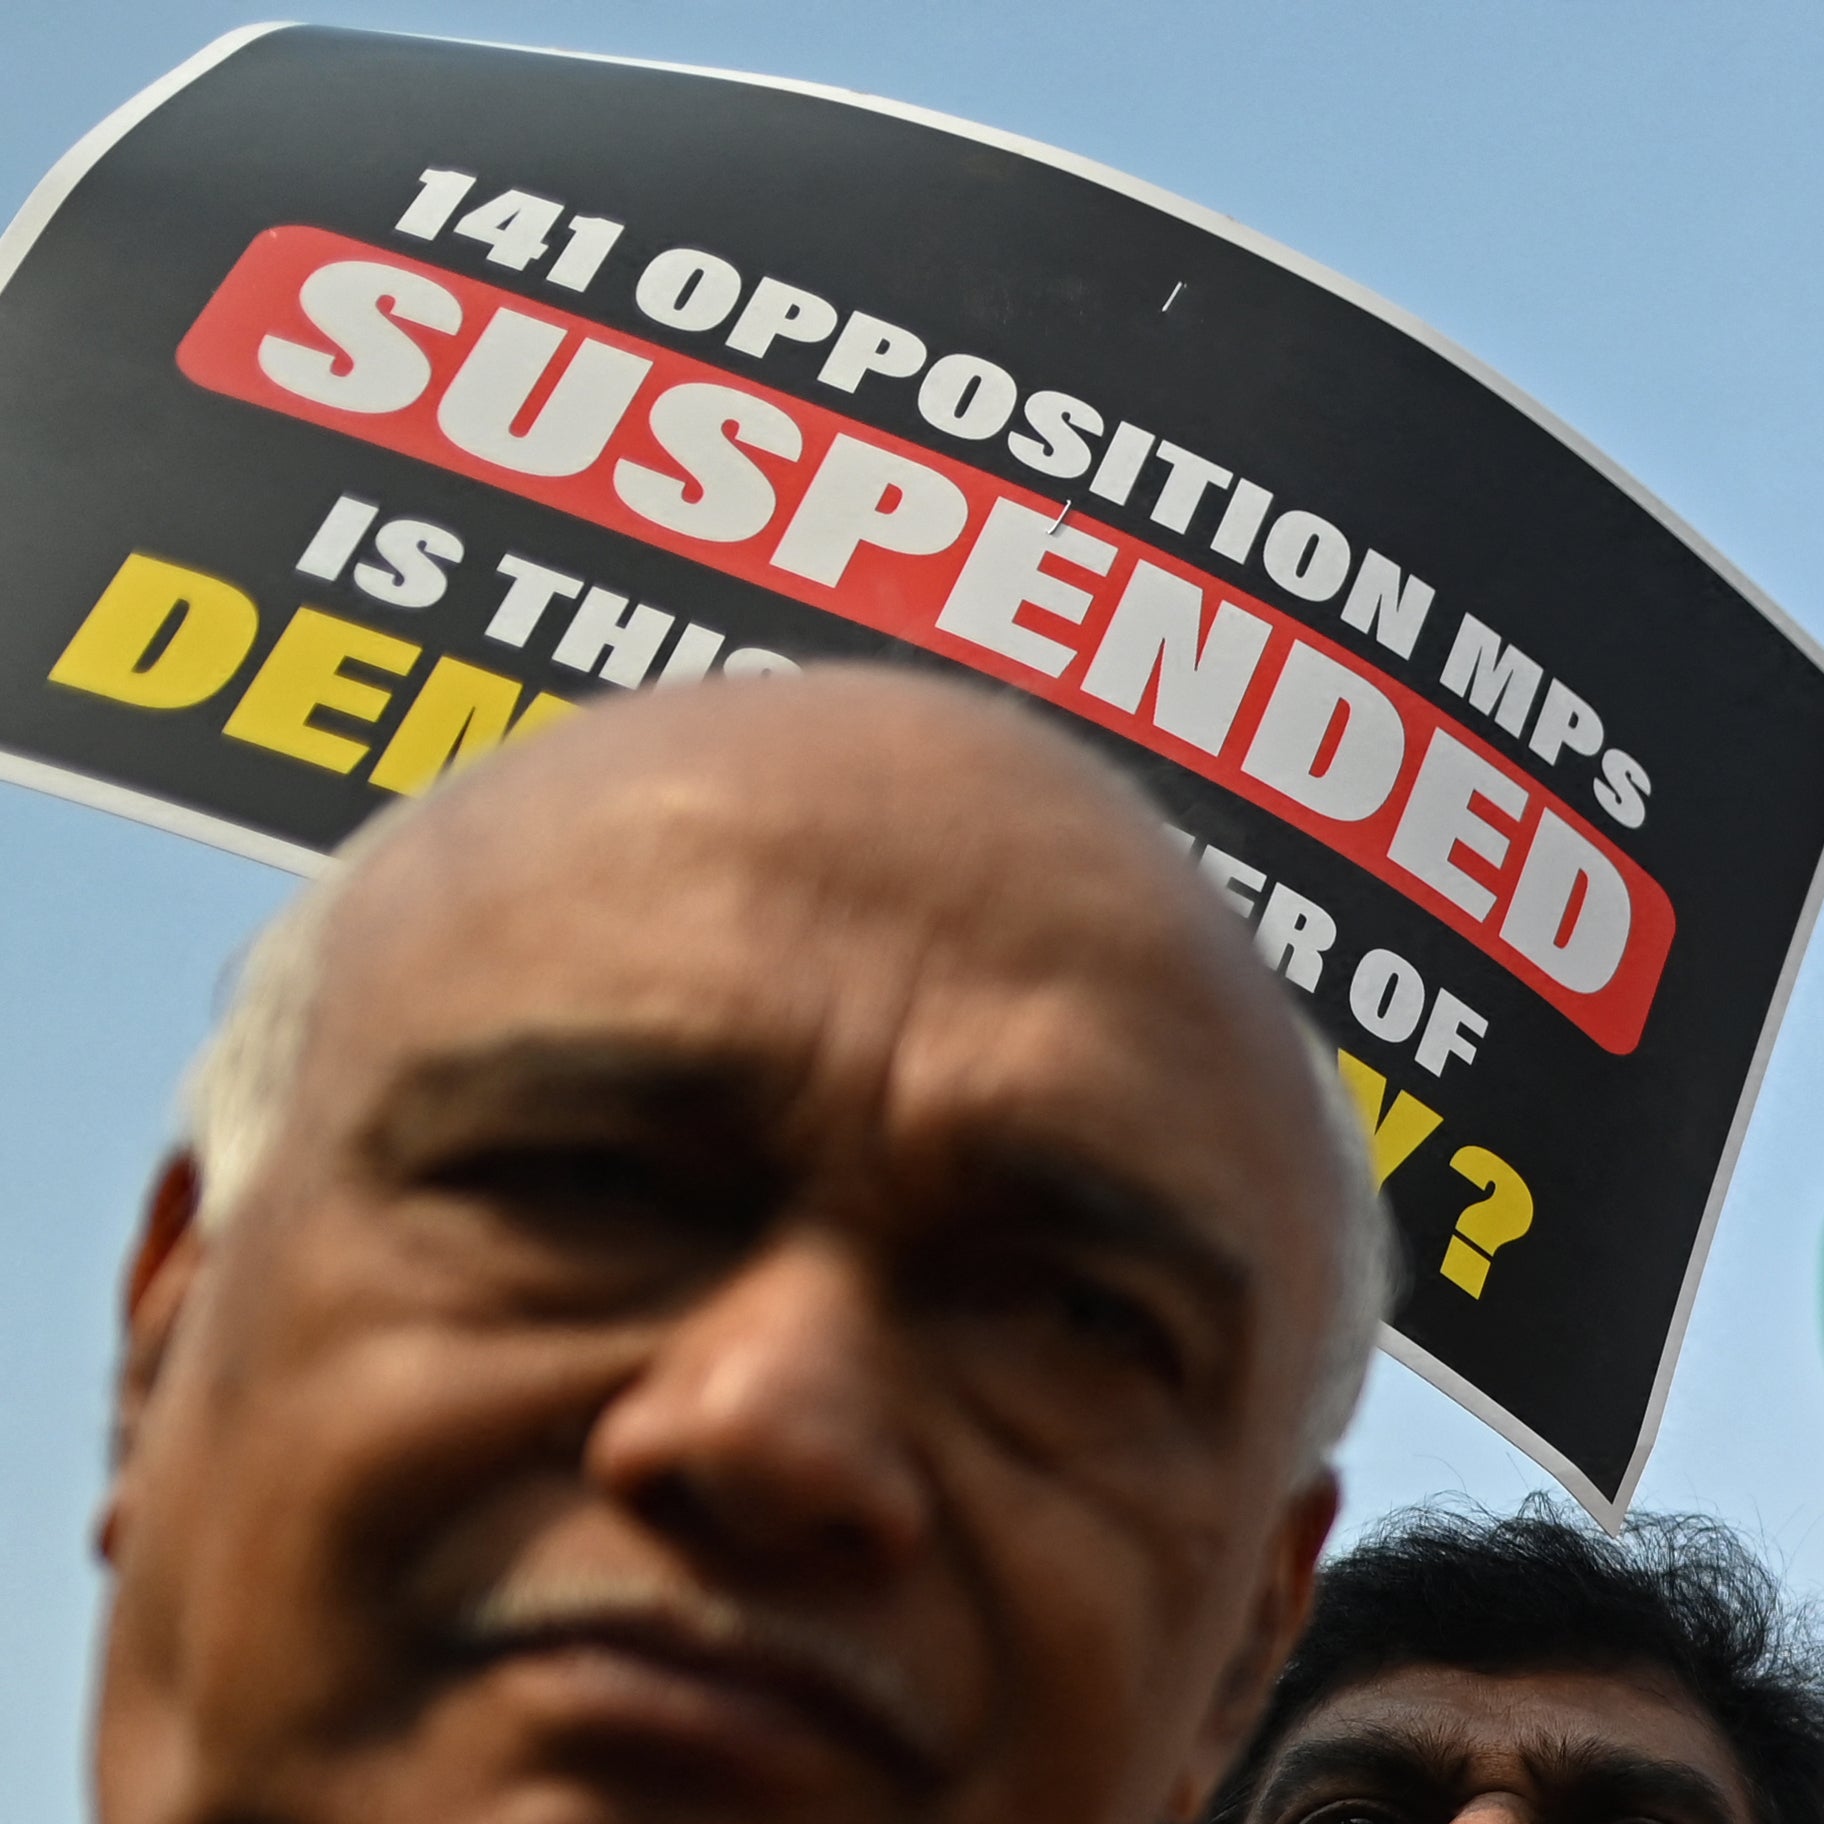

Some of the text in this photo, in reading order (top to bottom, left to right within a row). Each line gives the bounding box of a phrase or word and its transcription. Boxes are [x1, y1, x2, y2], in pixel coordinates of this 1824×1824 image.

[257, 260, 1632, 994] SUSPENDED
[296, 496, 466, 609] IS
[1349, 948, 1489, 1078] OF
[395, 168, 1653, 829] 141 OPPOSITION MPs
